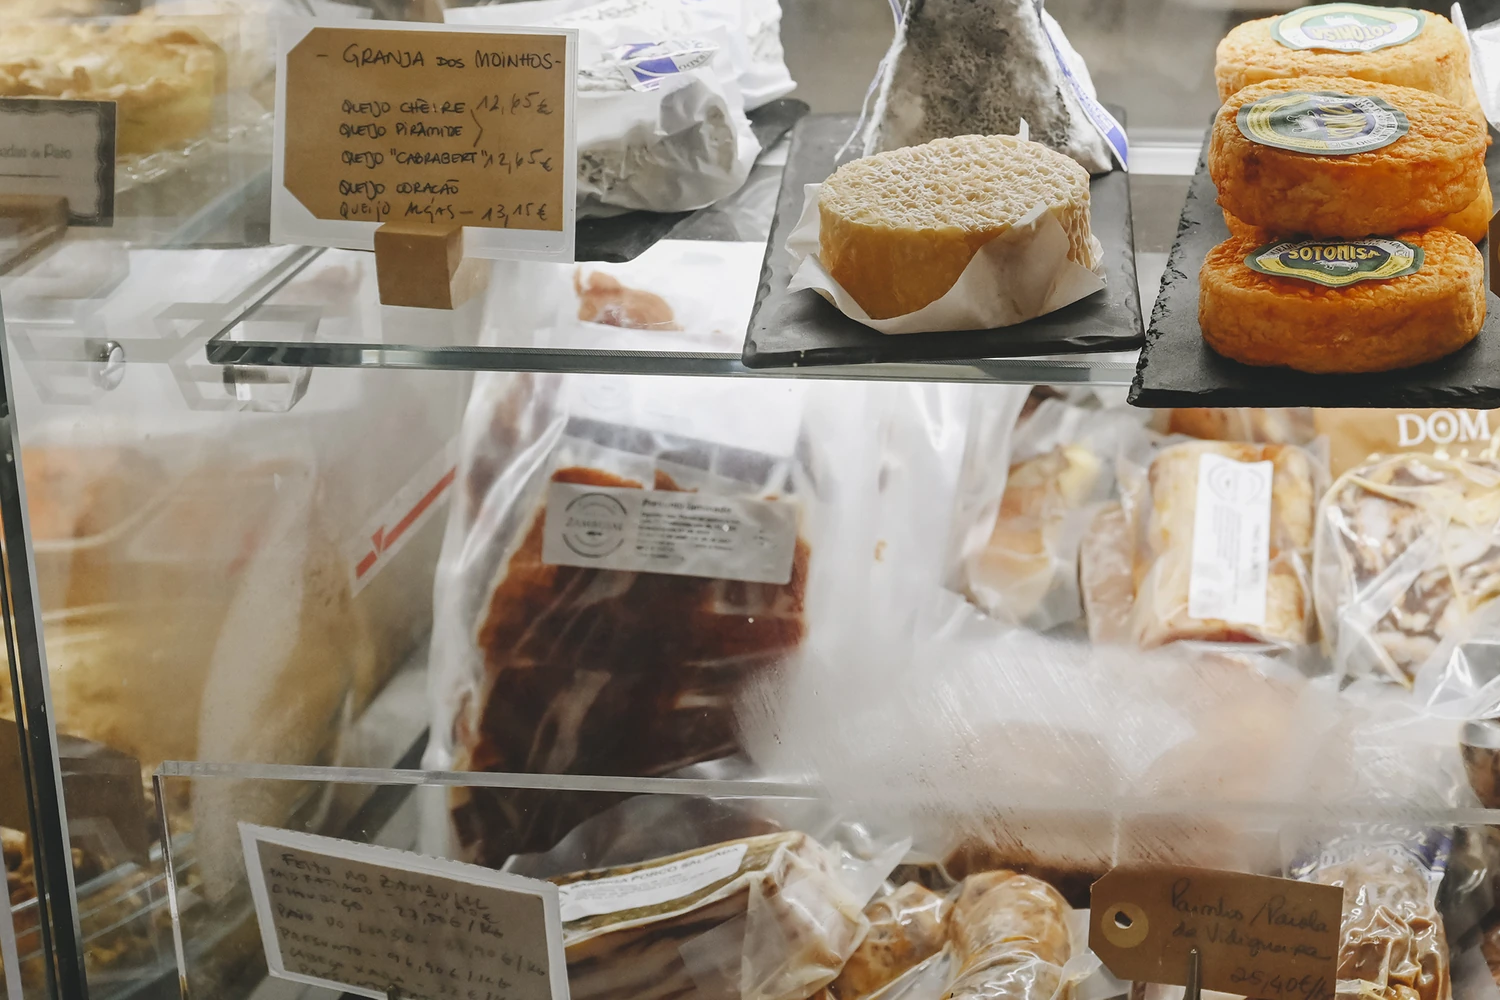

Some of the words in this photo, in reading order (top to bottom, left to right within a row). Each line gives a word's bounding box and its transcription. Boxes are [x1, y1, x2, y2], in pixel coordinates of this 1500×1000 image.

[343, 44, 425, 68] GRANJA
[436, 56, 466, 68] DOS
[341, 100, 391, 115] QUEIJO
[339, 124, 387, 139] QUEIJO
[339, 180, 385, 200] QUEIJO
[340, 202, 391, 222] QUEIJO
[1398, 411, 1492, 447] DOM
